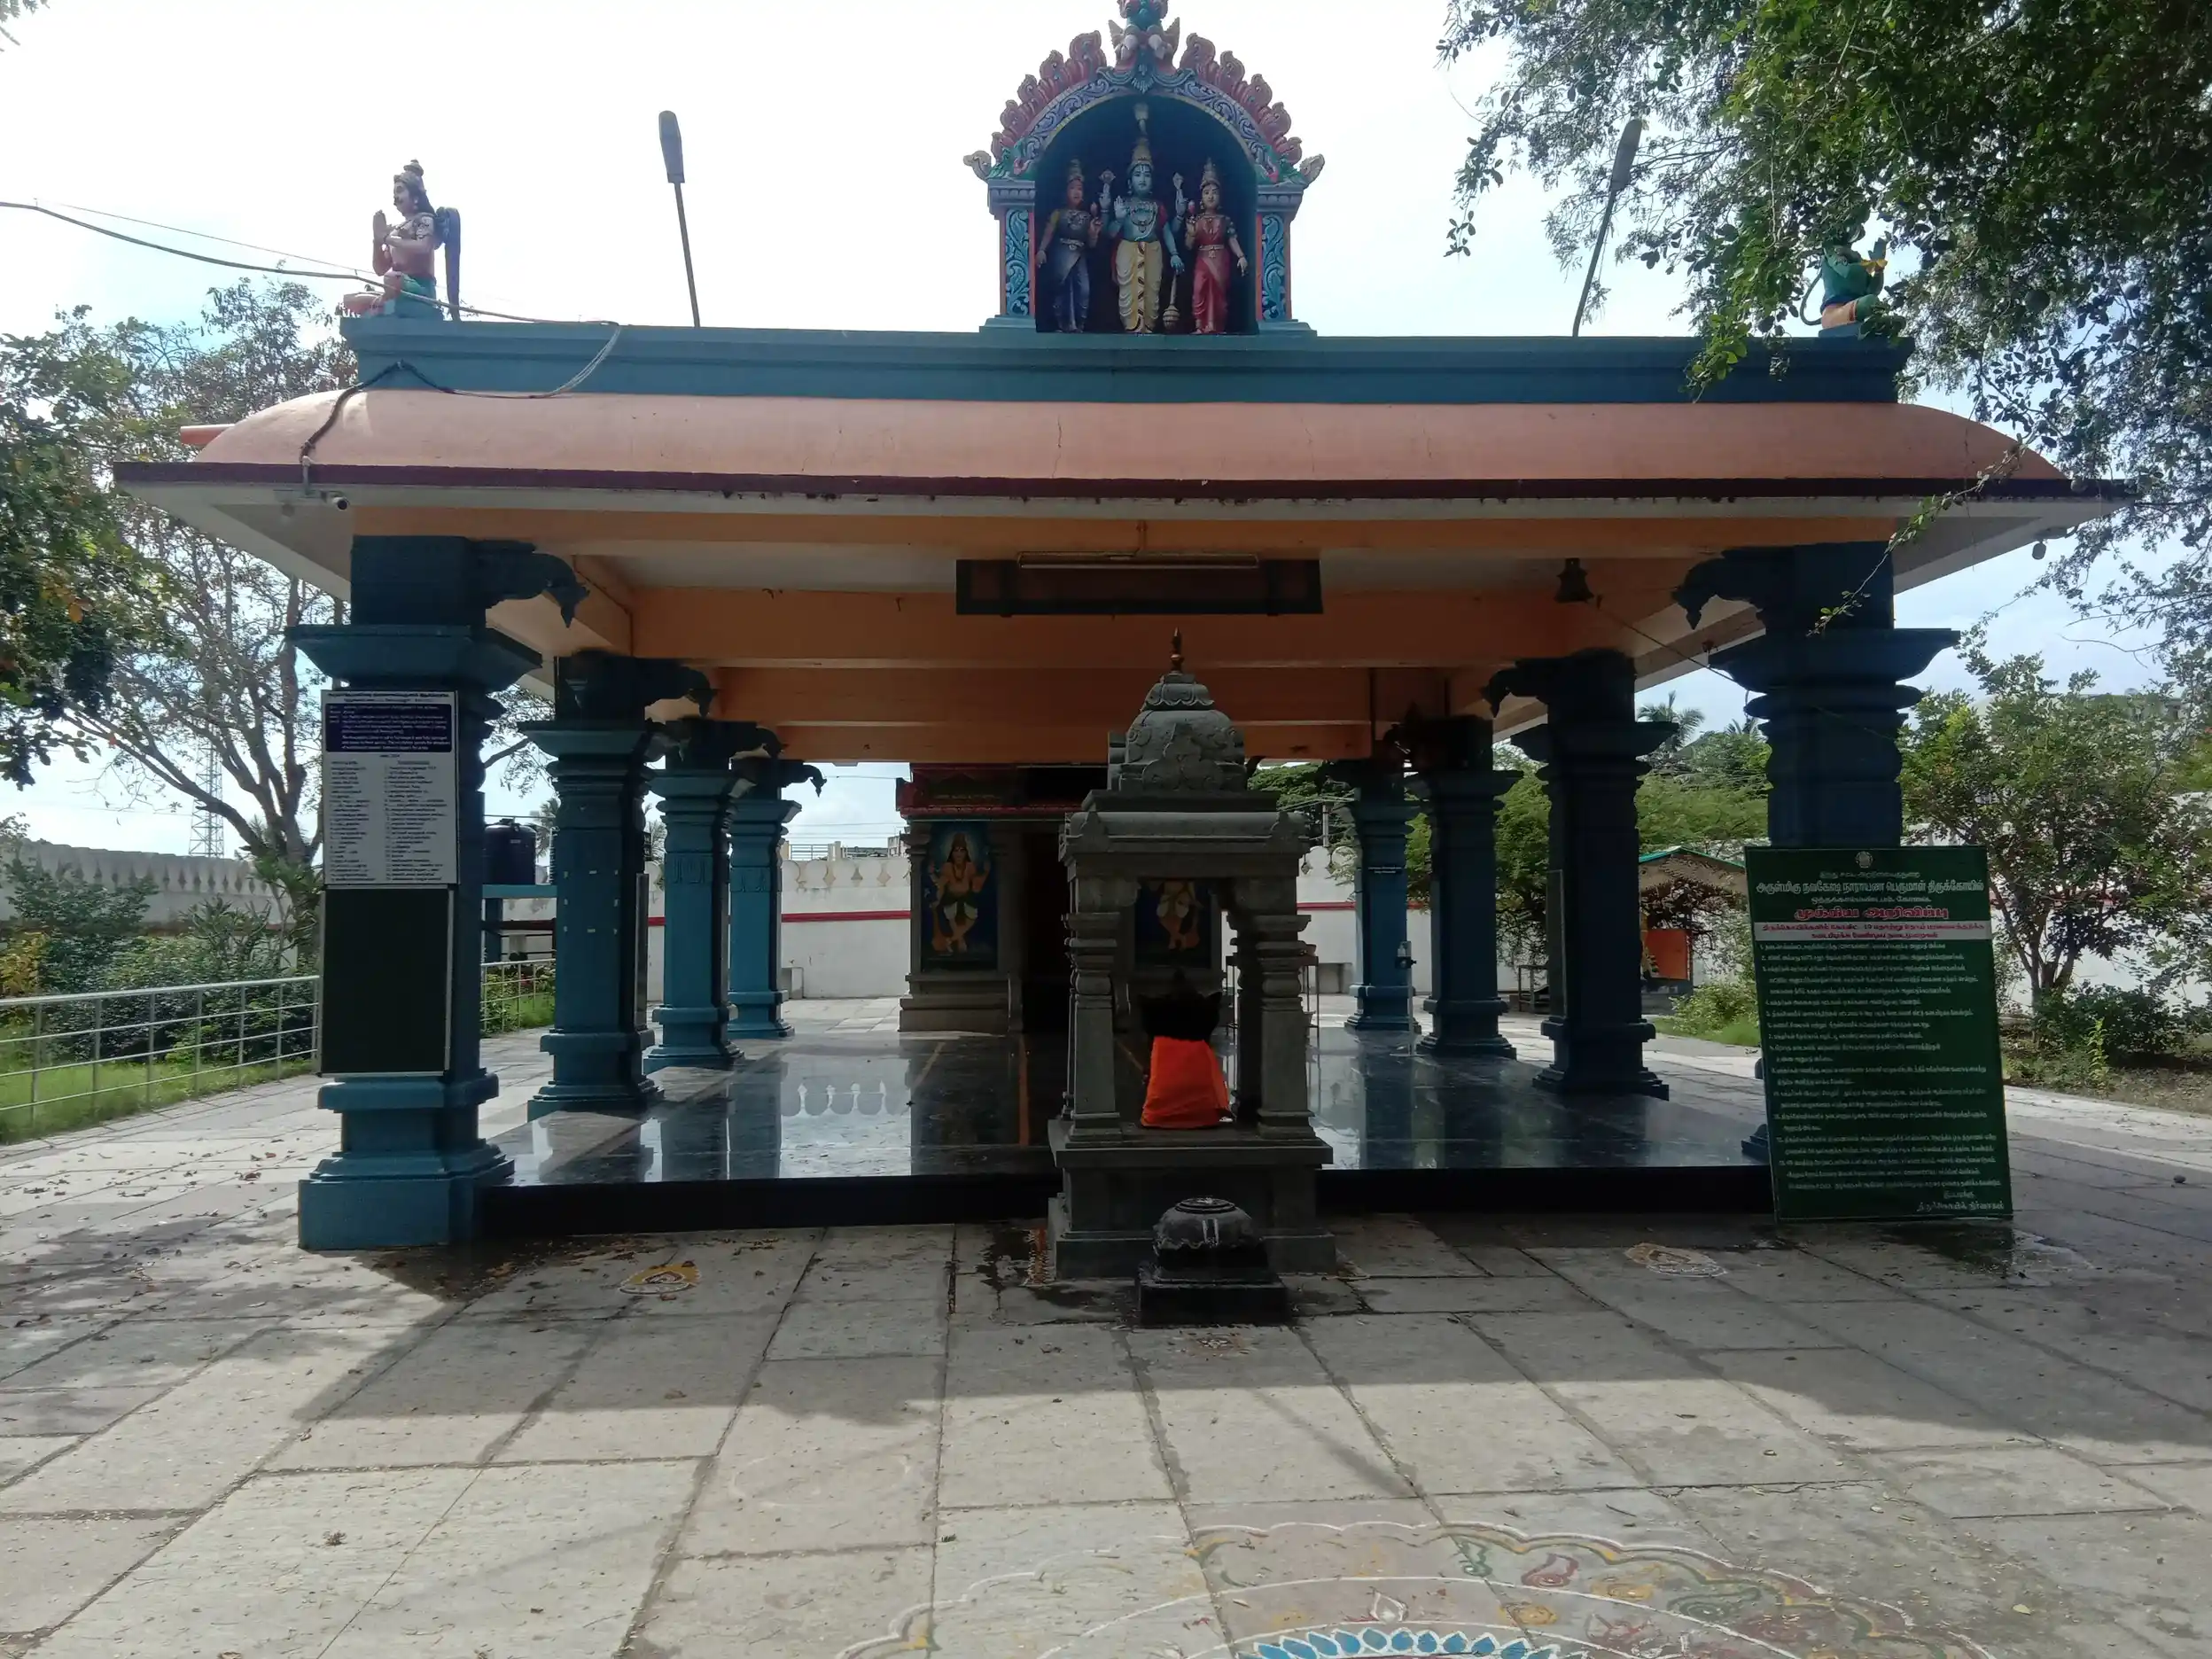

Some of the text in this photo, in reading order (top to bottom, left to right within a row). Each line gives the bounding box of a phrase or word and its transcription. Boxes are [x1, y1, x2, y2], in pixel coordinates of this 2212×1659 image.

[1756, 879, 1802, 895] அருள்மிகு
[1886, 879, 1927, 894] பெருமாள்
[1794, 905, 1950, 921] முக்கிய அறிவிப்பு
